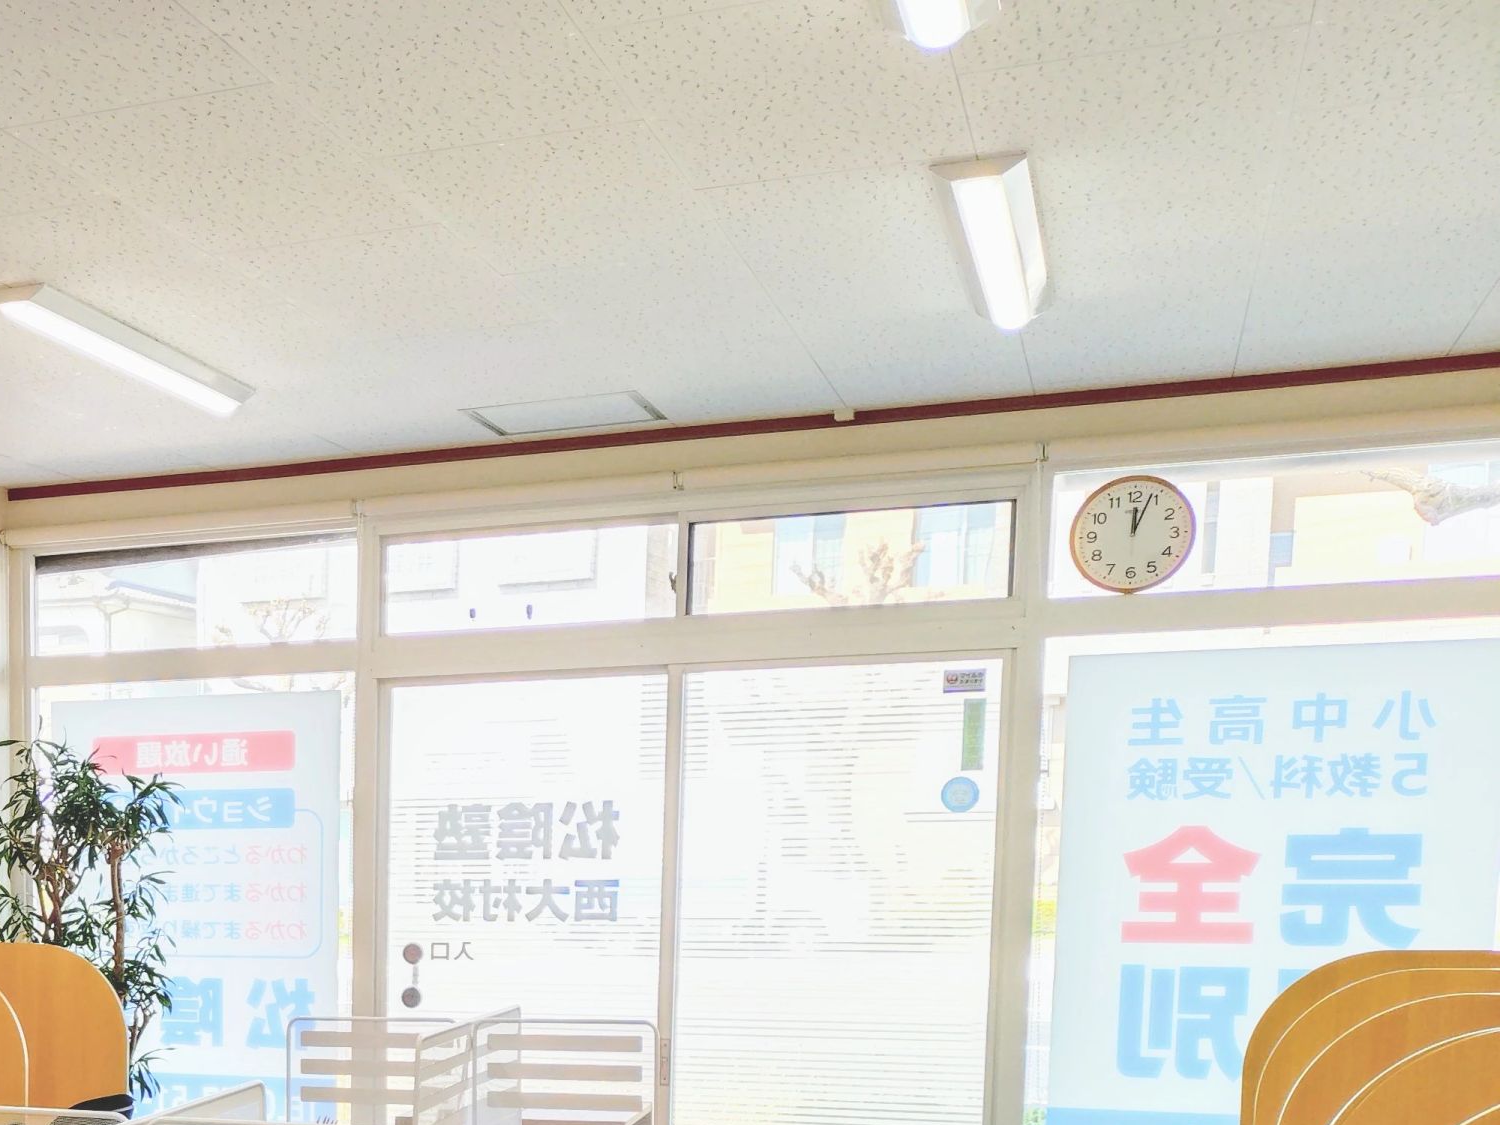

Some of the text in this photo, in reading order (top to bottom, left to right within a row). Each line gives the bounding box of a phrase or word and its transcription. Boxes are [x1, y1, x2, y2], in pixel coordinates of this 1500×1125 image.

[1109, 497, 1120, 508] 11
[1127, 491, 1142, 503] 12
[1154, 494, 1158, 505] 1
[1092, 513, 1107, 524] 10
[1164, 508, 1175, 520] 2
[1087, 532, 1097, 543] 9
[1170, 527, 1179, 538] 3
[1091, 550, 1102, 561] 8
[1161, 546, 1172, 557] 4
[1106, 564, 1116, 575] 7
[1126, 567, 1136, 578] 6
[1146, 561, 1157, 573] 5
